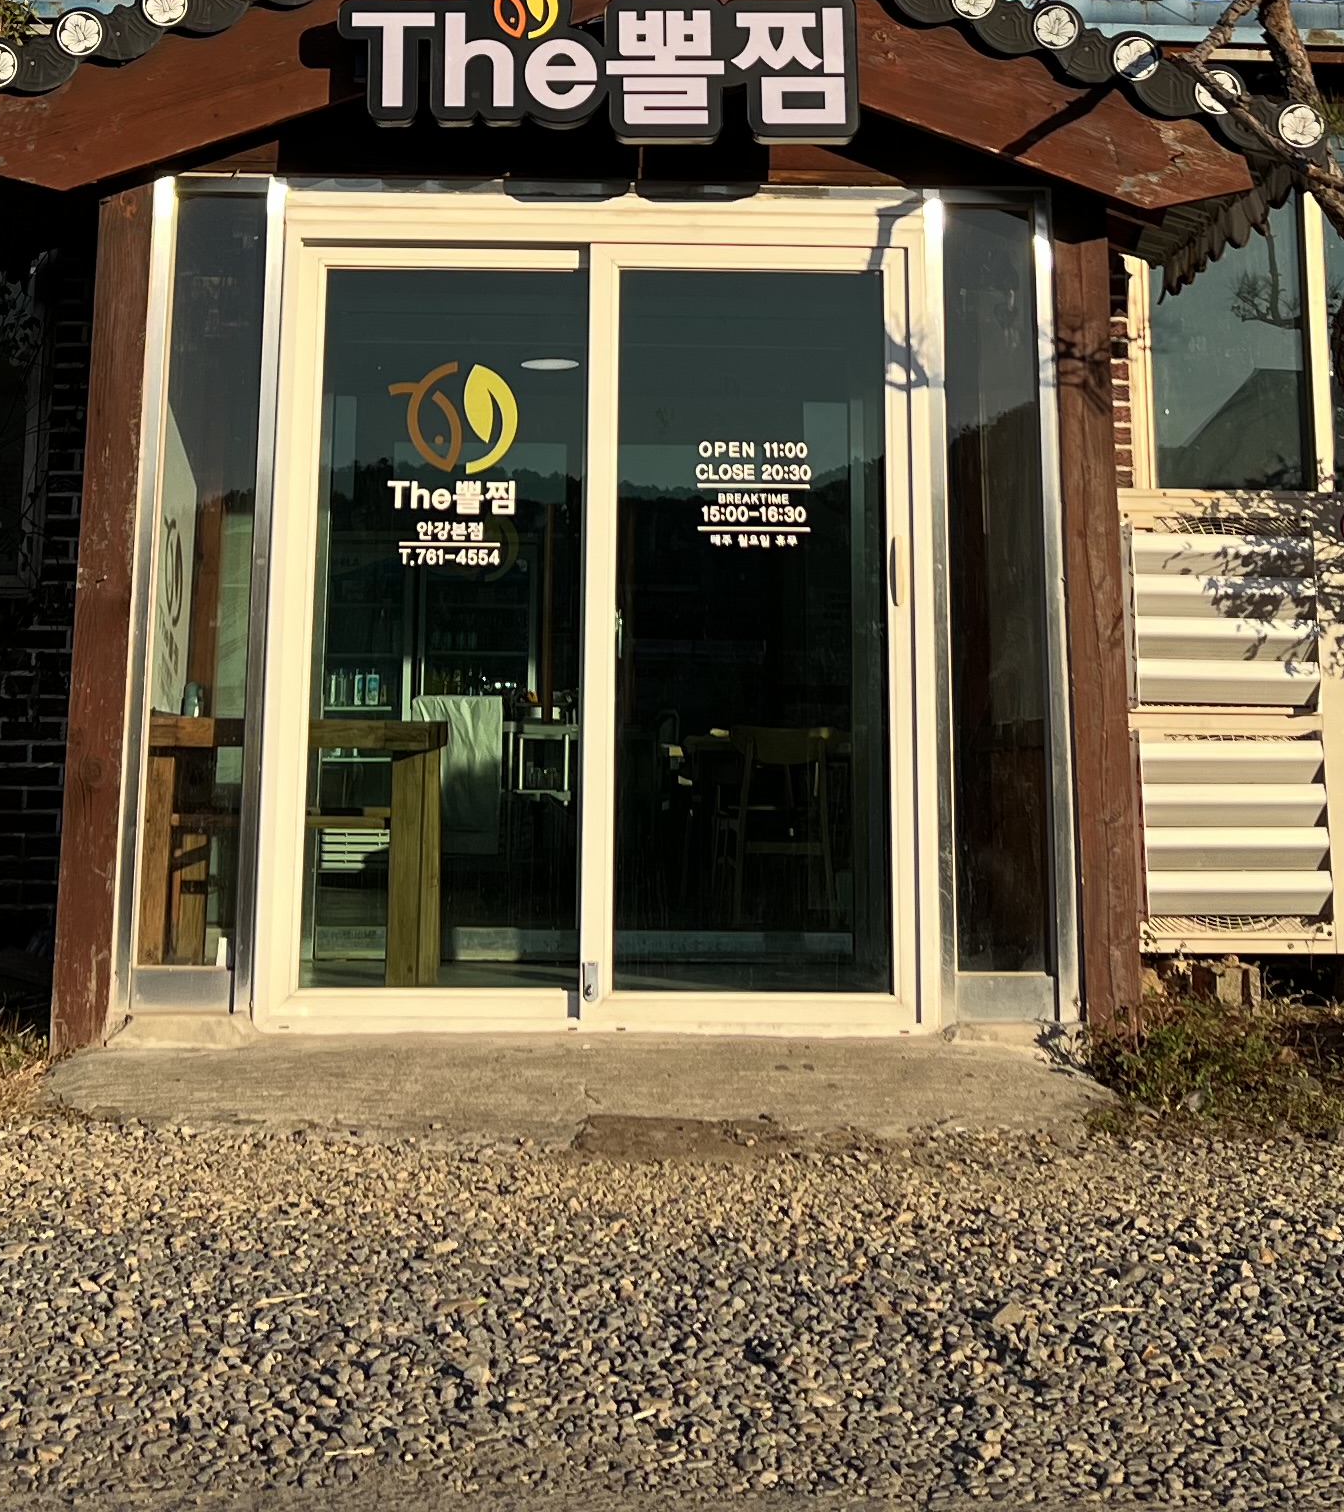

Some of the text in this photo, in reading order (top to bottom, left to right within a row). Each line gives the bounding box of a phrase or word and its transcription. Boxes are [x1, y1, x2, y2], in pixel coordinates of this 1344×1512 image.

[698, 440, 808, 459] OPEN 11:00
[695, 463, 812, 481] CLOSE 20:30
[717, 492, 790, 505] BREAKTIME
[701, 505, 807, 523] 15:00-16:30
[416, 520, 484, 541] 안강본점
[398, 548, 500, 566] T.761-4554
